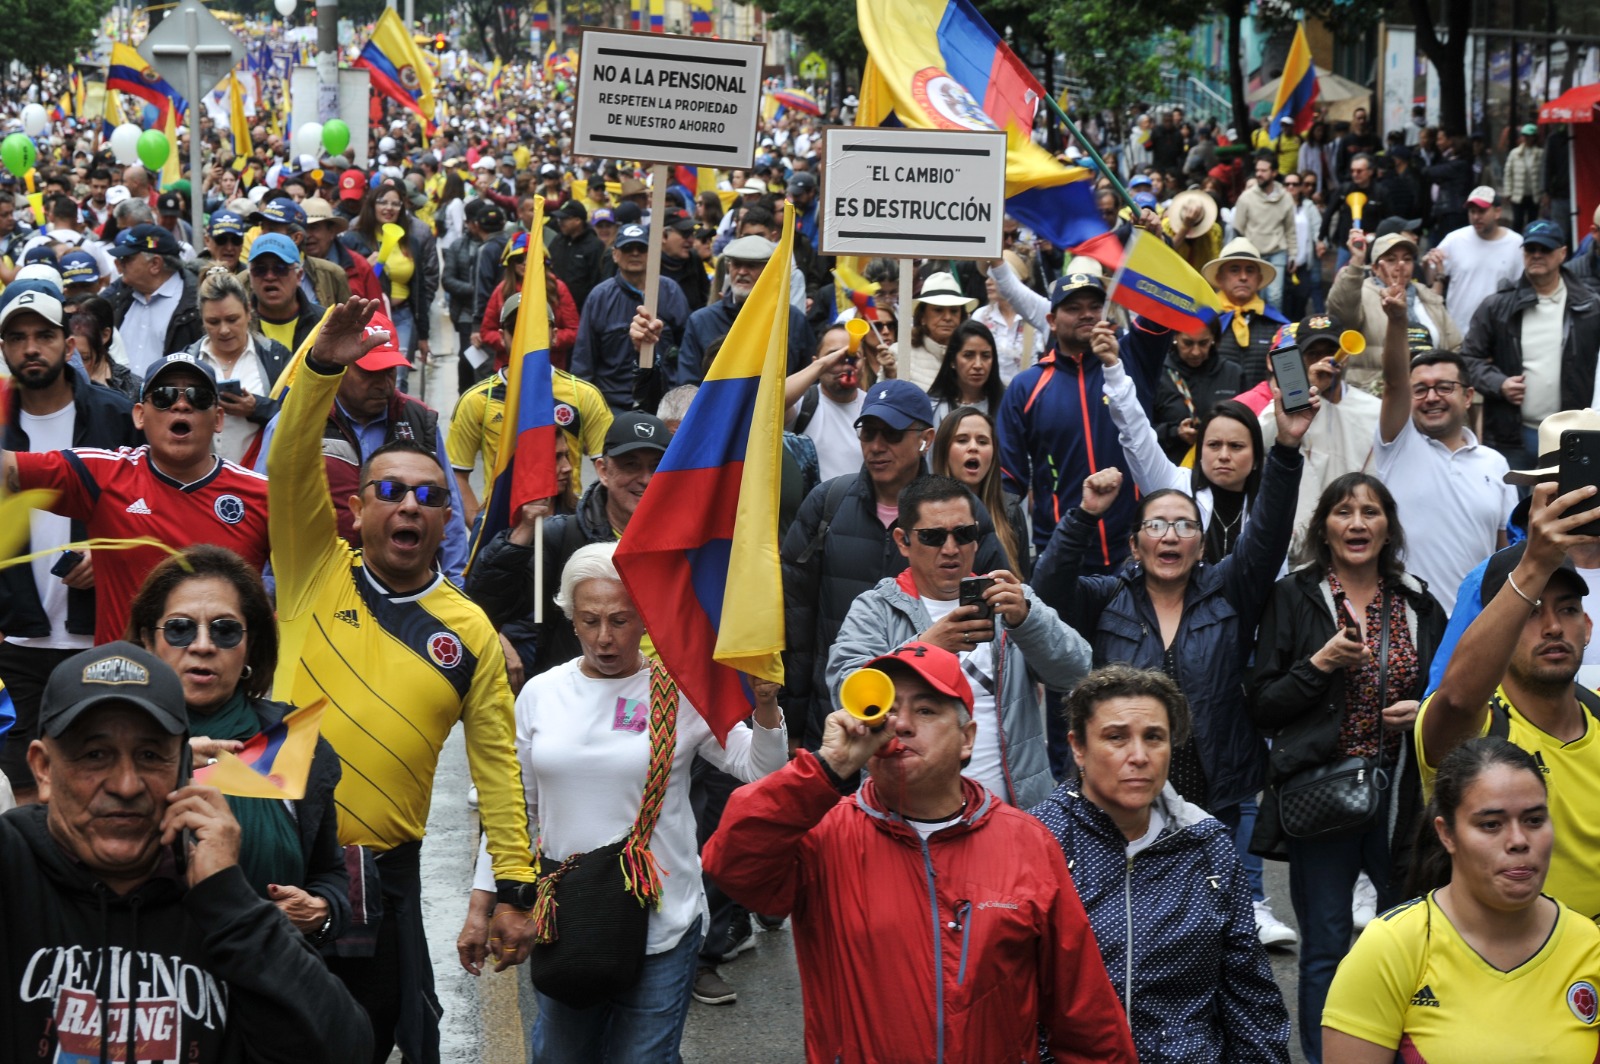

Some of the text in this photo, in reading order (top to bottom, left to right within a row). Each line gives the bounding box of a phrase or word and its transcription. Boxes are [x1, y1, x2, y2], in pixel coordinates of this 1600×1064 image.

[593, 64, 747, 94] NO A LA PENSIONAL
[598, 92, 738, 114] RESPETEN LA PROPIEDAD
[607, 113, 725, 133] DE NUESTRO AHORRO
[835, 196, 991, 222] ES DESTRUCCIÓN
[58, 997, 175, 1044] RACING
